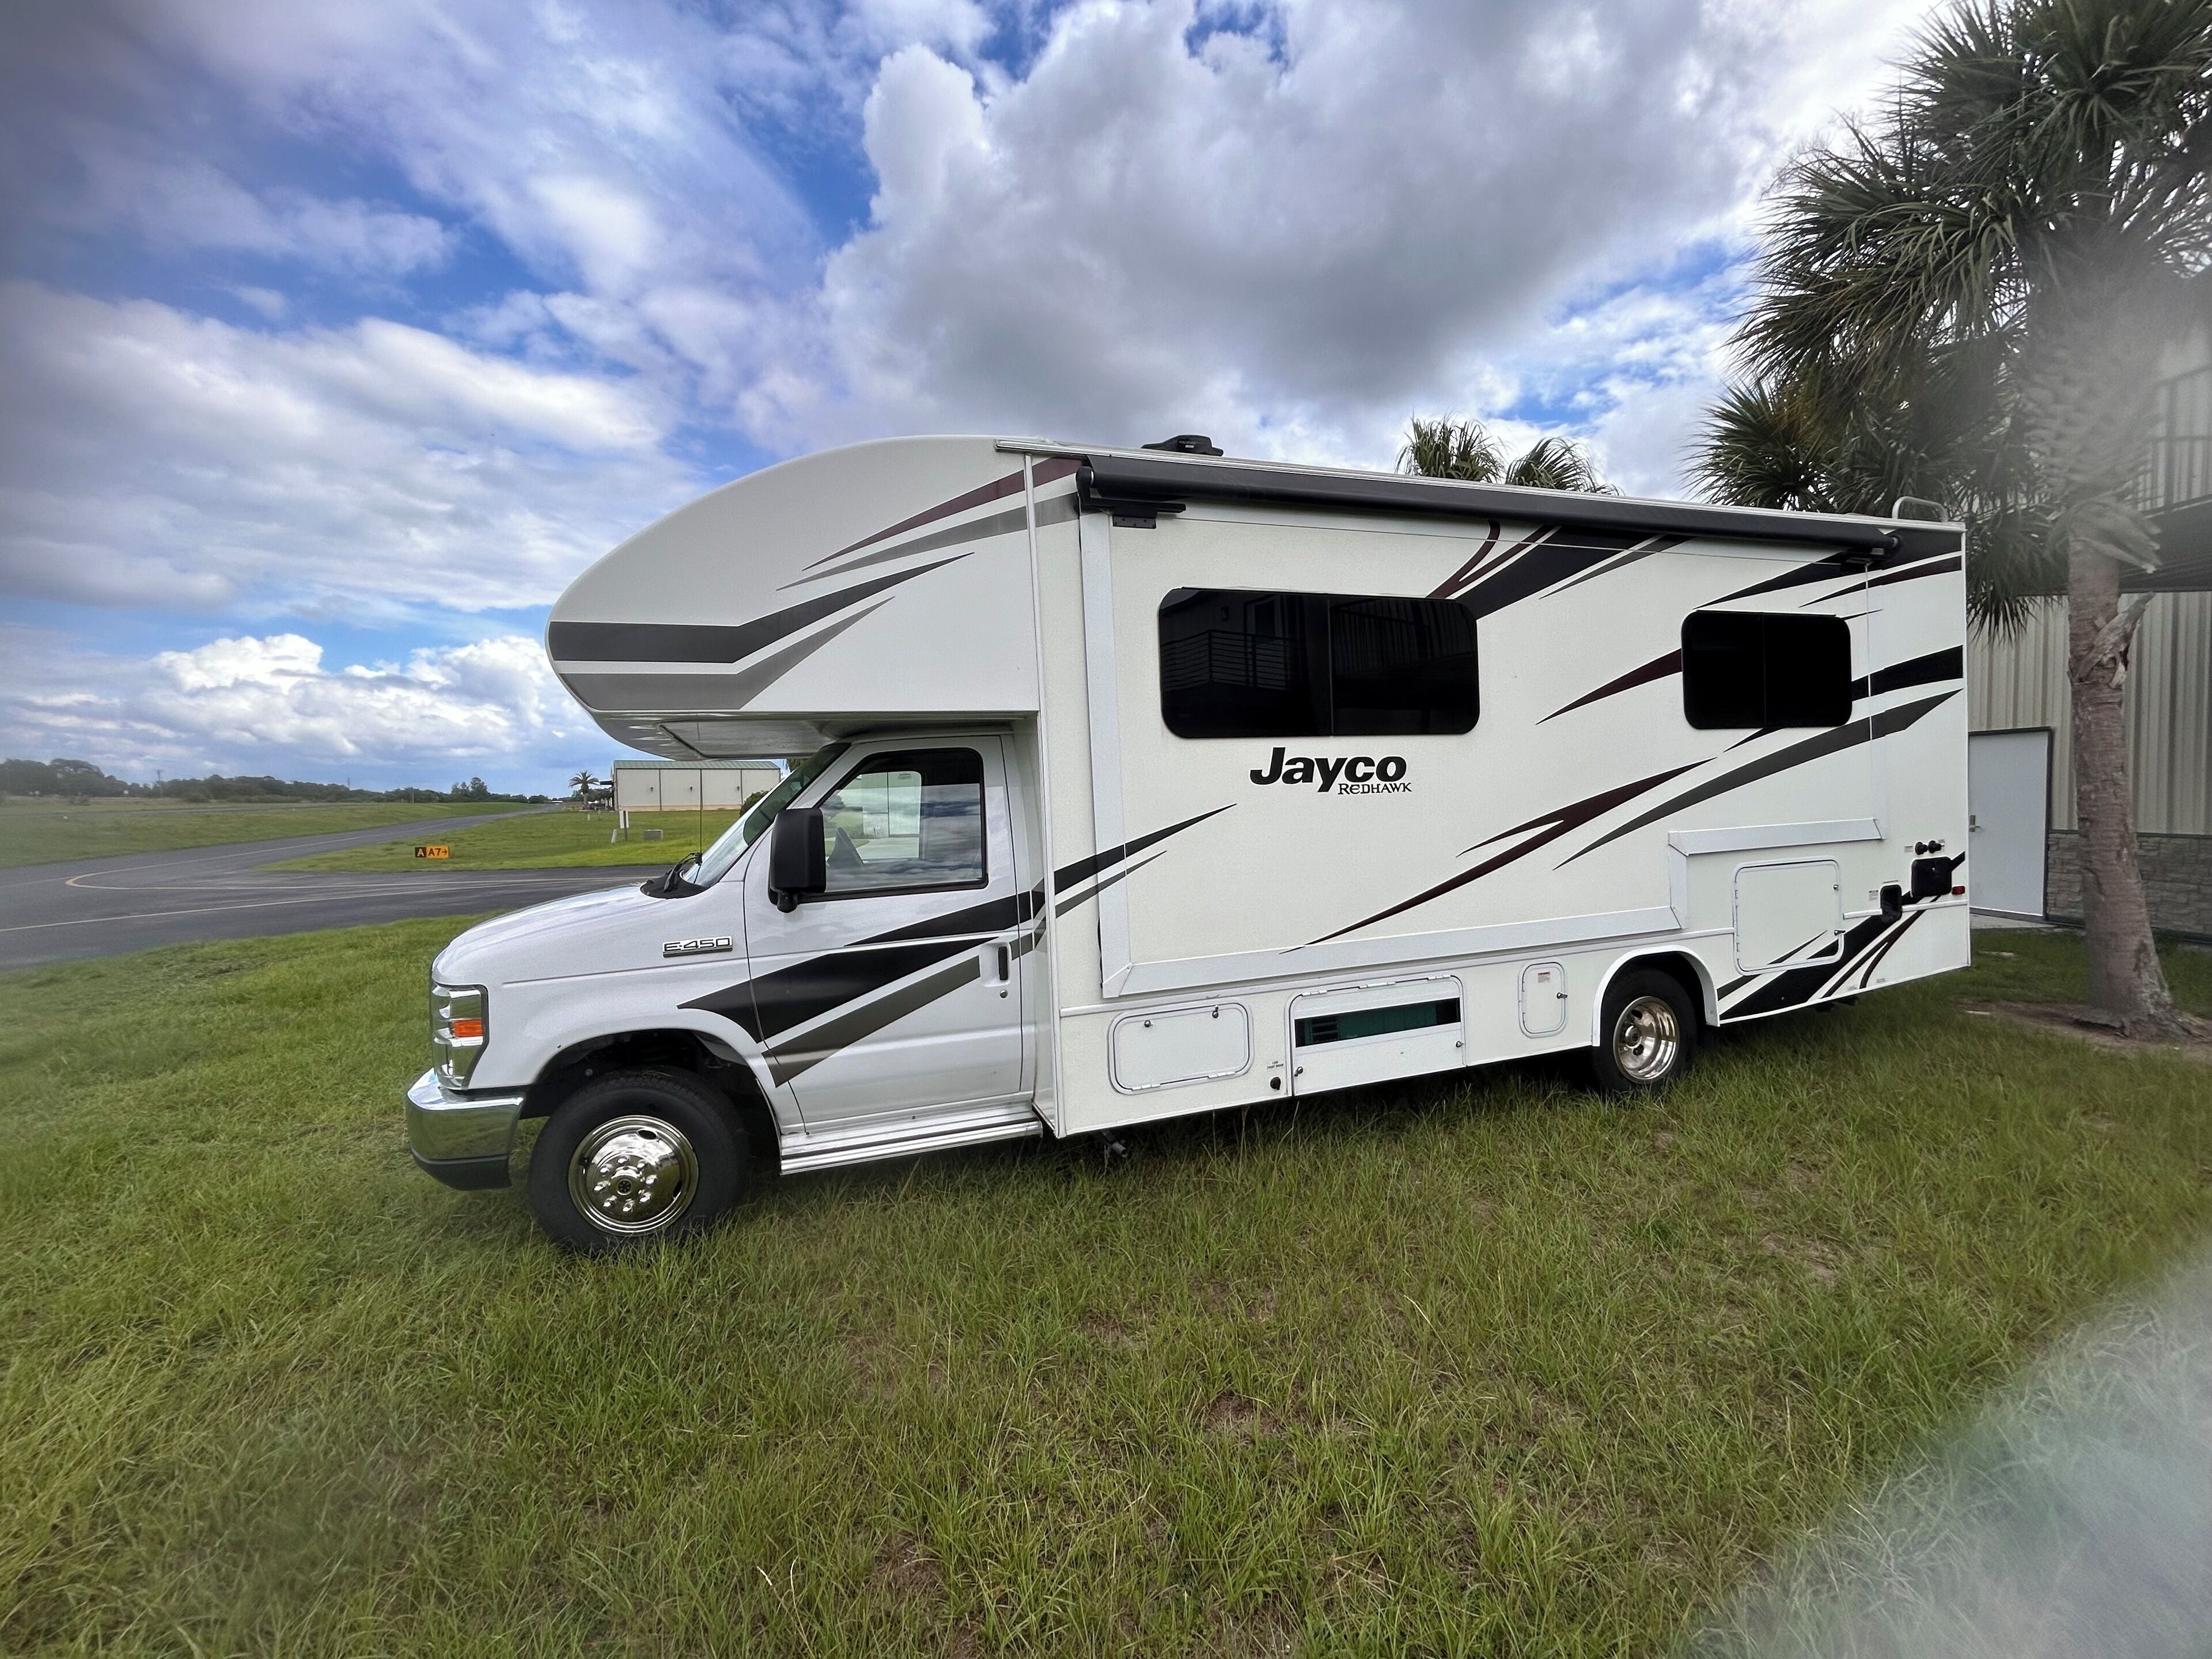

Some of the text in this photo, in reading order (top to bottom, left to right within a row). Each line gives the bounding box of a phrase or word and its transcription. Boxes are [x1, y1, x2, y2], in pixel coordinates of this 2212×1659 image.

[1249, 747, 1407, 793] Jayco
[416, 848, 441, 857] A A7
[664, 937, 731, 952] E-450
